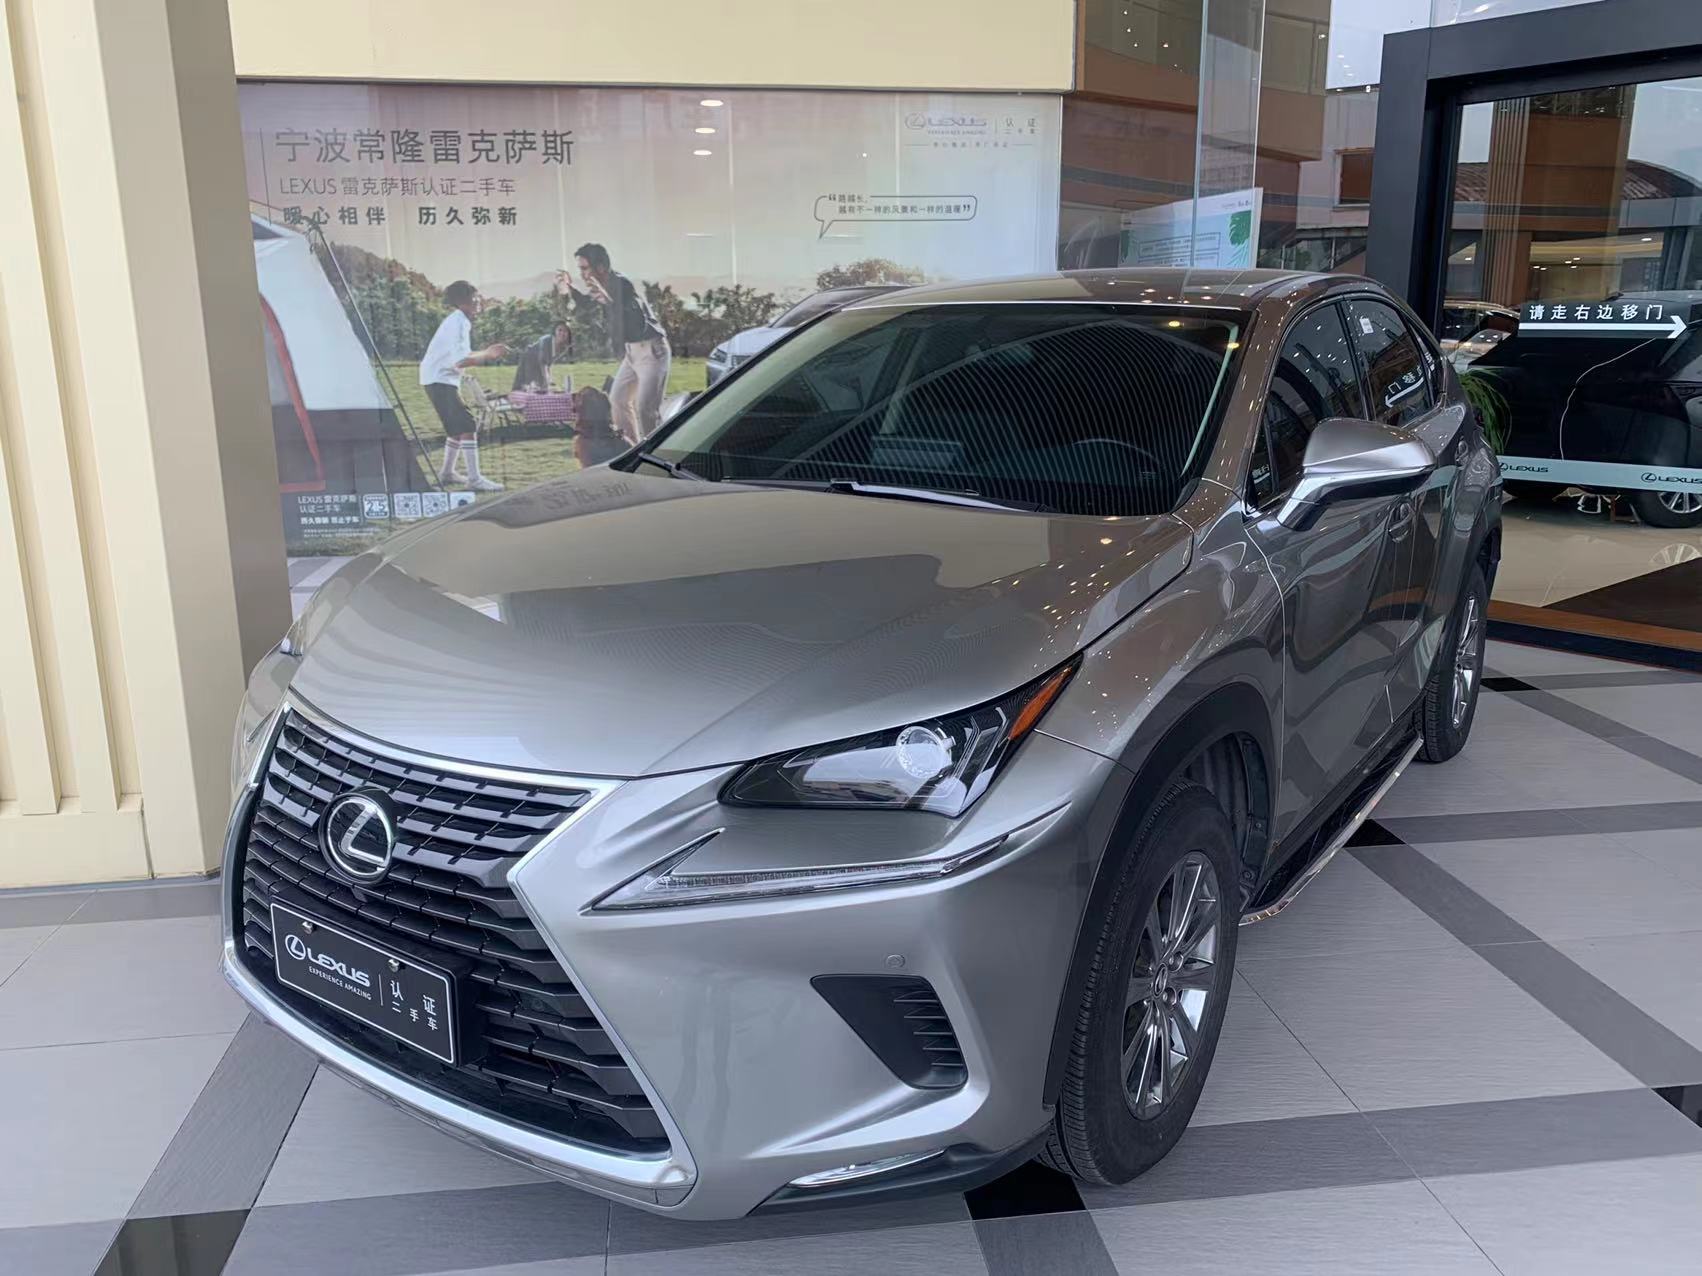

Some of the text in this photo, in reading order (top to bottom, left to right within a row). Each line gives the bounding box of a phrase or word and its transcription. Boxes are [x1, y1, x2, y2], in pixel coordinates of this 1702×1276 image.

[275, 128, 575, 166] 宁波常隆雷克萨斯
[279, 176, 516, 197] LEXUS 雷克萨斯认证二手车
[283, 206, 518, 226] 暖心相伴 历久弥新
[1529, 304, 1663, 320] 请走右边移门
[1509, 465, 1549, 473] LEXUS
[297, 495, 322, 504] LEXUS
[307, 947, 371, 987] LEXUS
[308, 966, 372, 1001] EXPERIENCE AMAZING
